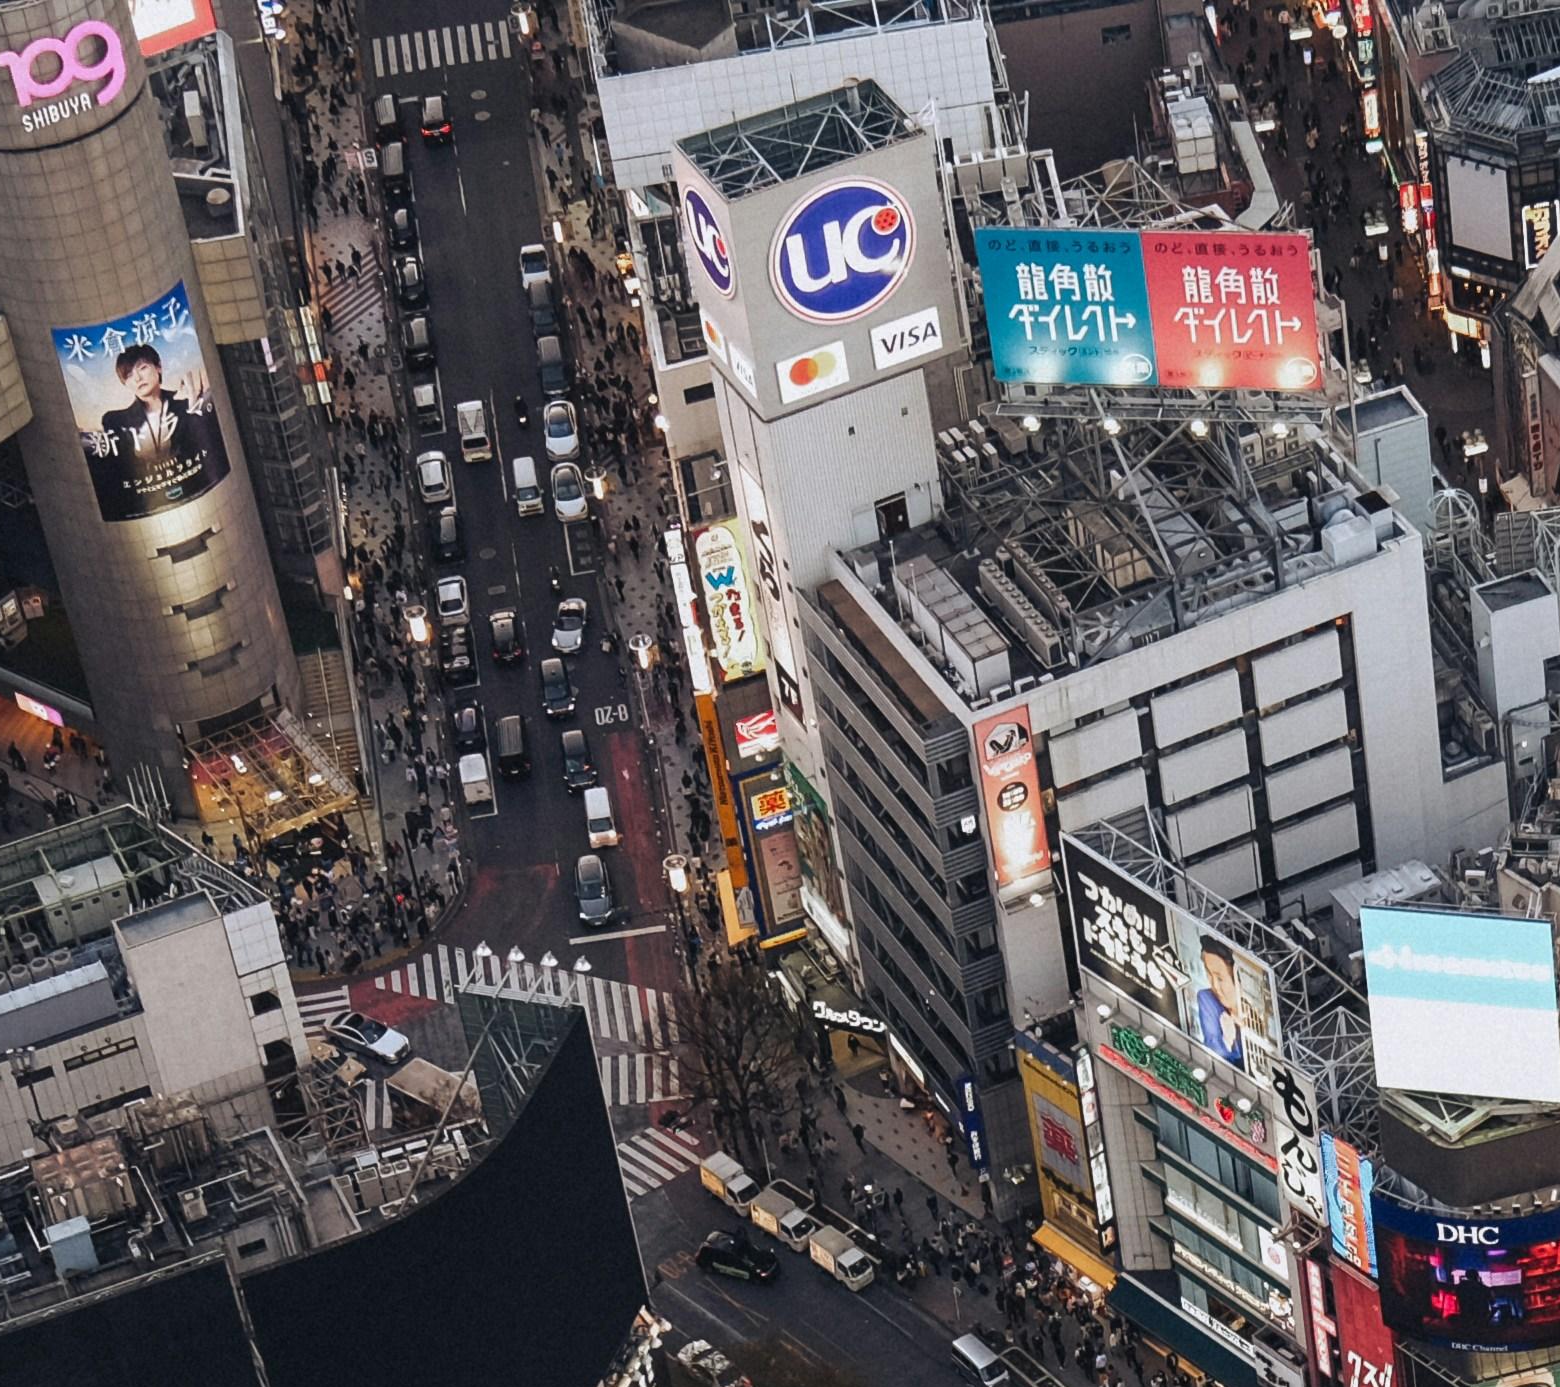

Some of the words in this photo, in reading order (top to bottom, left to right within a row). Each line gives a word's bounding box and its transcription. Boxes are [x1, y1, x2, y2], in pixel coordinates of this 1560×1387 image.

[22, 92, 91, 133] SHIBUYA
[786, 203, 901, 293] UC
[1016, 262, 1115, 302] 龍角散
[1182, 266, 1281, 306] 龍角散
[63, 297, 182, 361] 米倉涼子
[881, 321, 938, 354] VISA
[1272, 1062, 1324, 1219] もんじゃ
[1437, 1222, 1500, 1246] DHC
[1452, 1341, 1471, 1352] DHC
[1474, 1343, 1509, 1353] Channel
